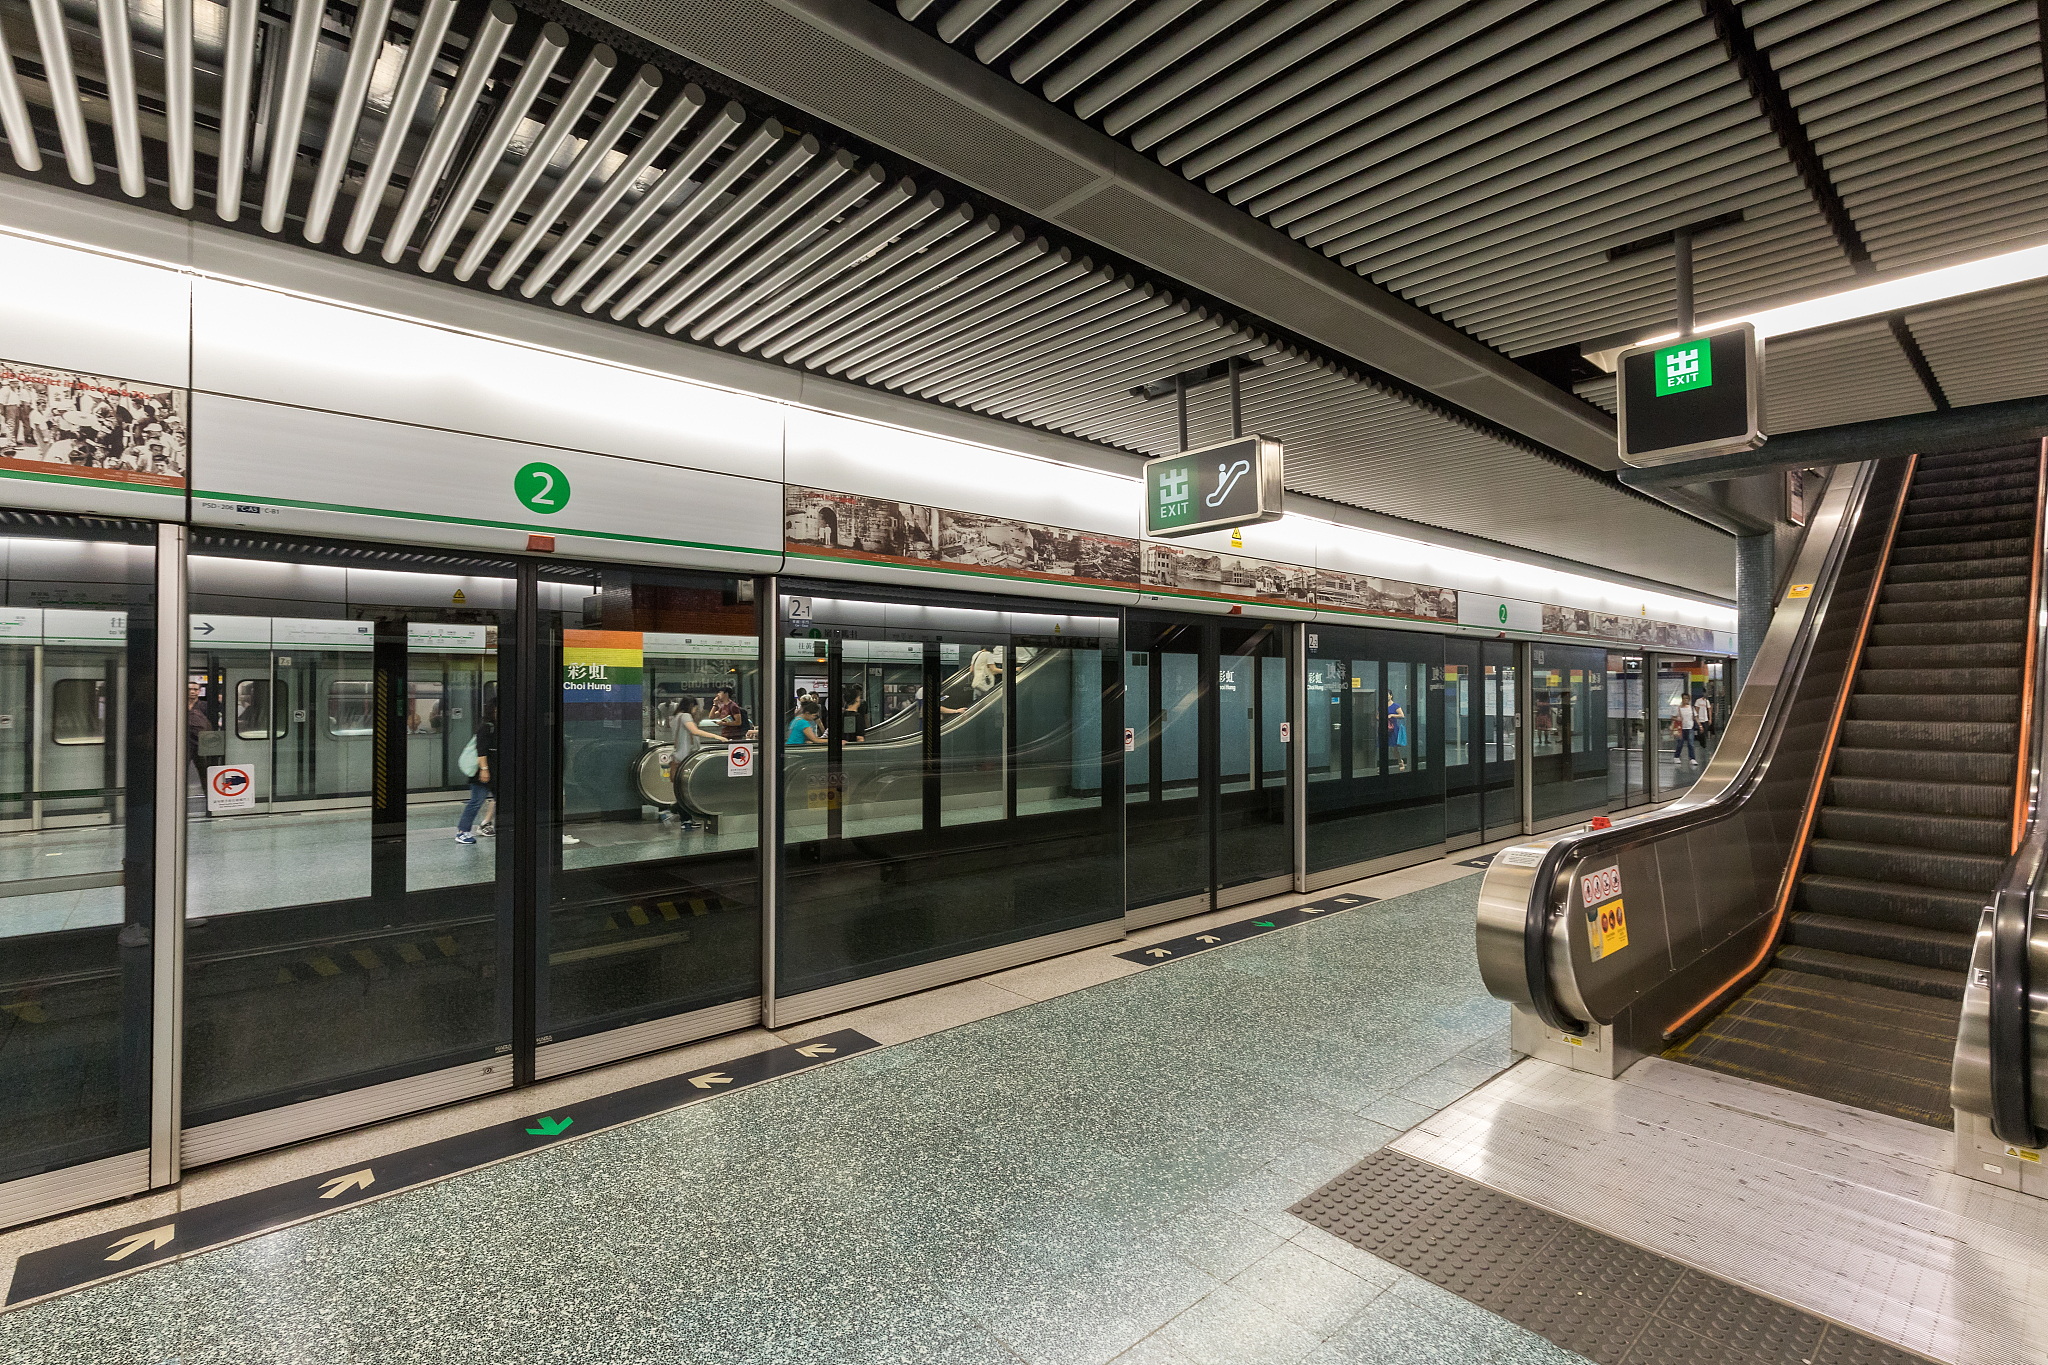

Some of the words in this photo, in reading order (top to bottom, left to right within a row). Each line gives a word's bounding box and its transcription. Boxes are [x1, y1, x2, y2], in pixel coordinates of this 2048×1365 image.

[1667, 349, 1699, 377] 出
[18, 373, 61, 387] District
[63, 379, 75, 388] in
[100, 386, 118, 395] 60s
[1668, 372, 1699, 387] EXIT
[531, 471, 555, 505] 2
[1160, 468, 1189, 505] 出
[1160, 502, 1189, 519] EXIT
[791, 599, 810, 617] 2-1
[1501, 607, 1505, 620] 2
[567, 662, 608, 680] 彩虹
[563, 681, 586, 690] Choi
[587, 682, 612, 692] Hung
